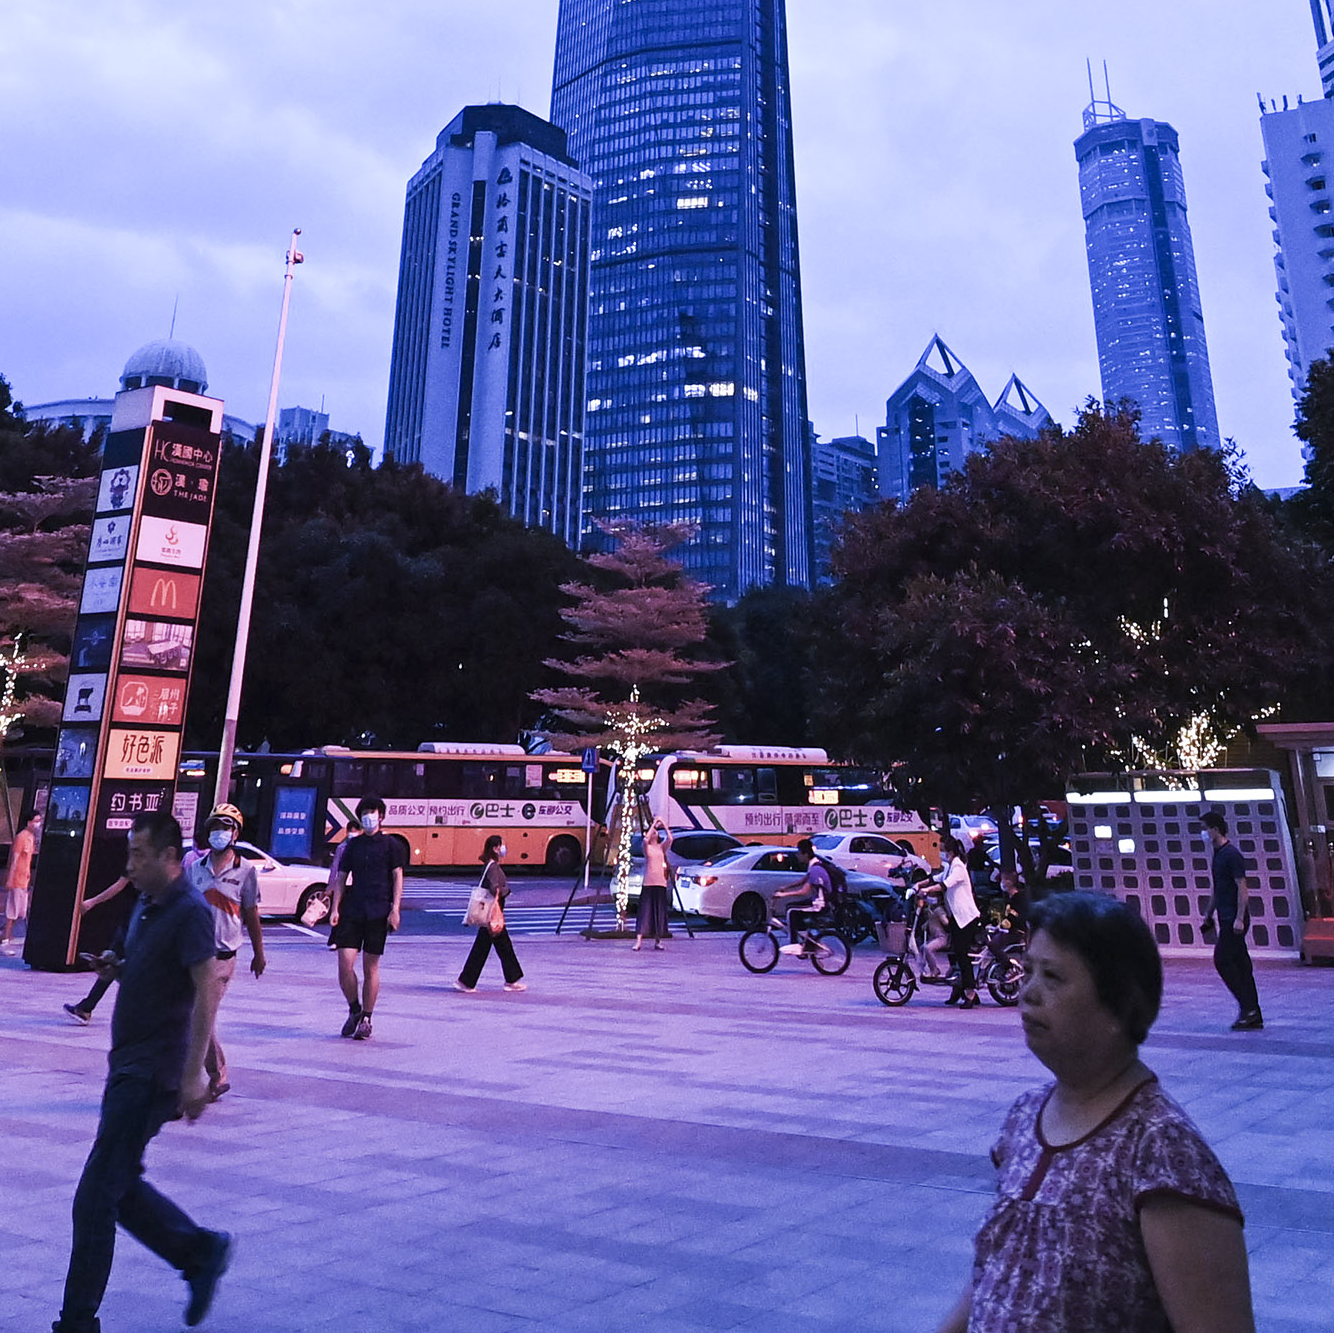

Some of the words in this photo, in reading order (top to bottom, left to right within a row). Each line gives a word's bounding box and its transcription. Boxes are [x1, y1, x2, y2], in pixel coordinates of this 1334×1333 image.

[173, 490, 188, 499] THE
[189, 492, 207, 502] JADE
[120, 733, 165, 764] 好色派
[110, 792, 160, 812] 约书亚
[388, 804, 425, 816] 品质公交
[429, 805, 465, 816] 预约出行
[538, 805, 573, 816] 东部公交
[745, 812, 780, 827] 预约出行
